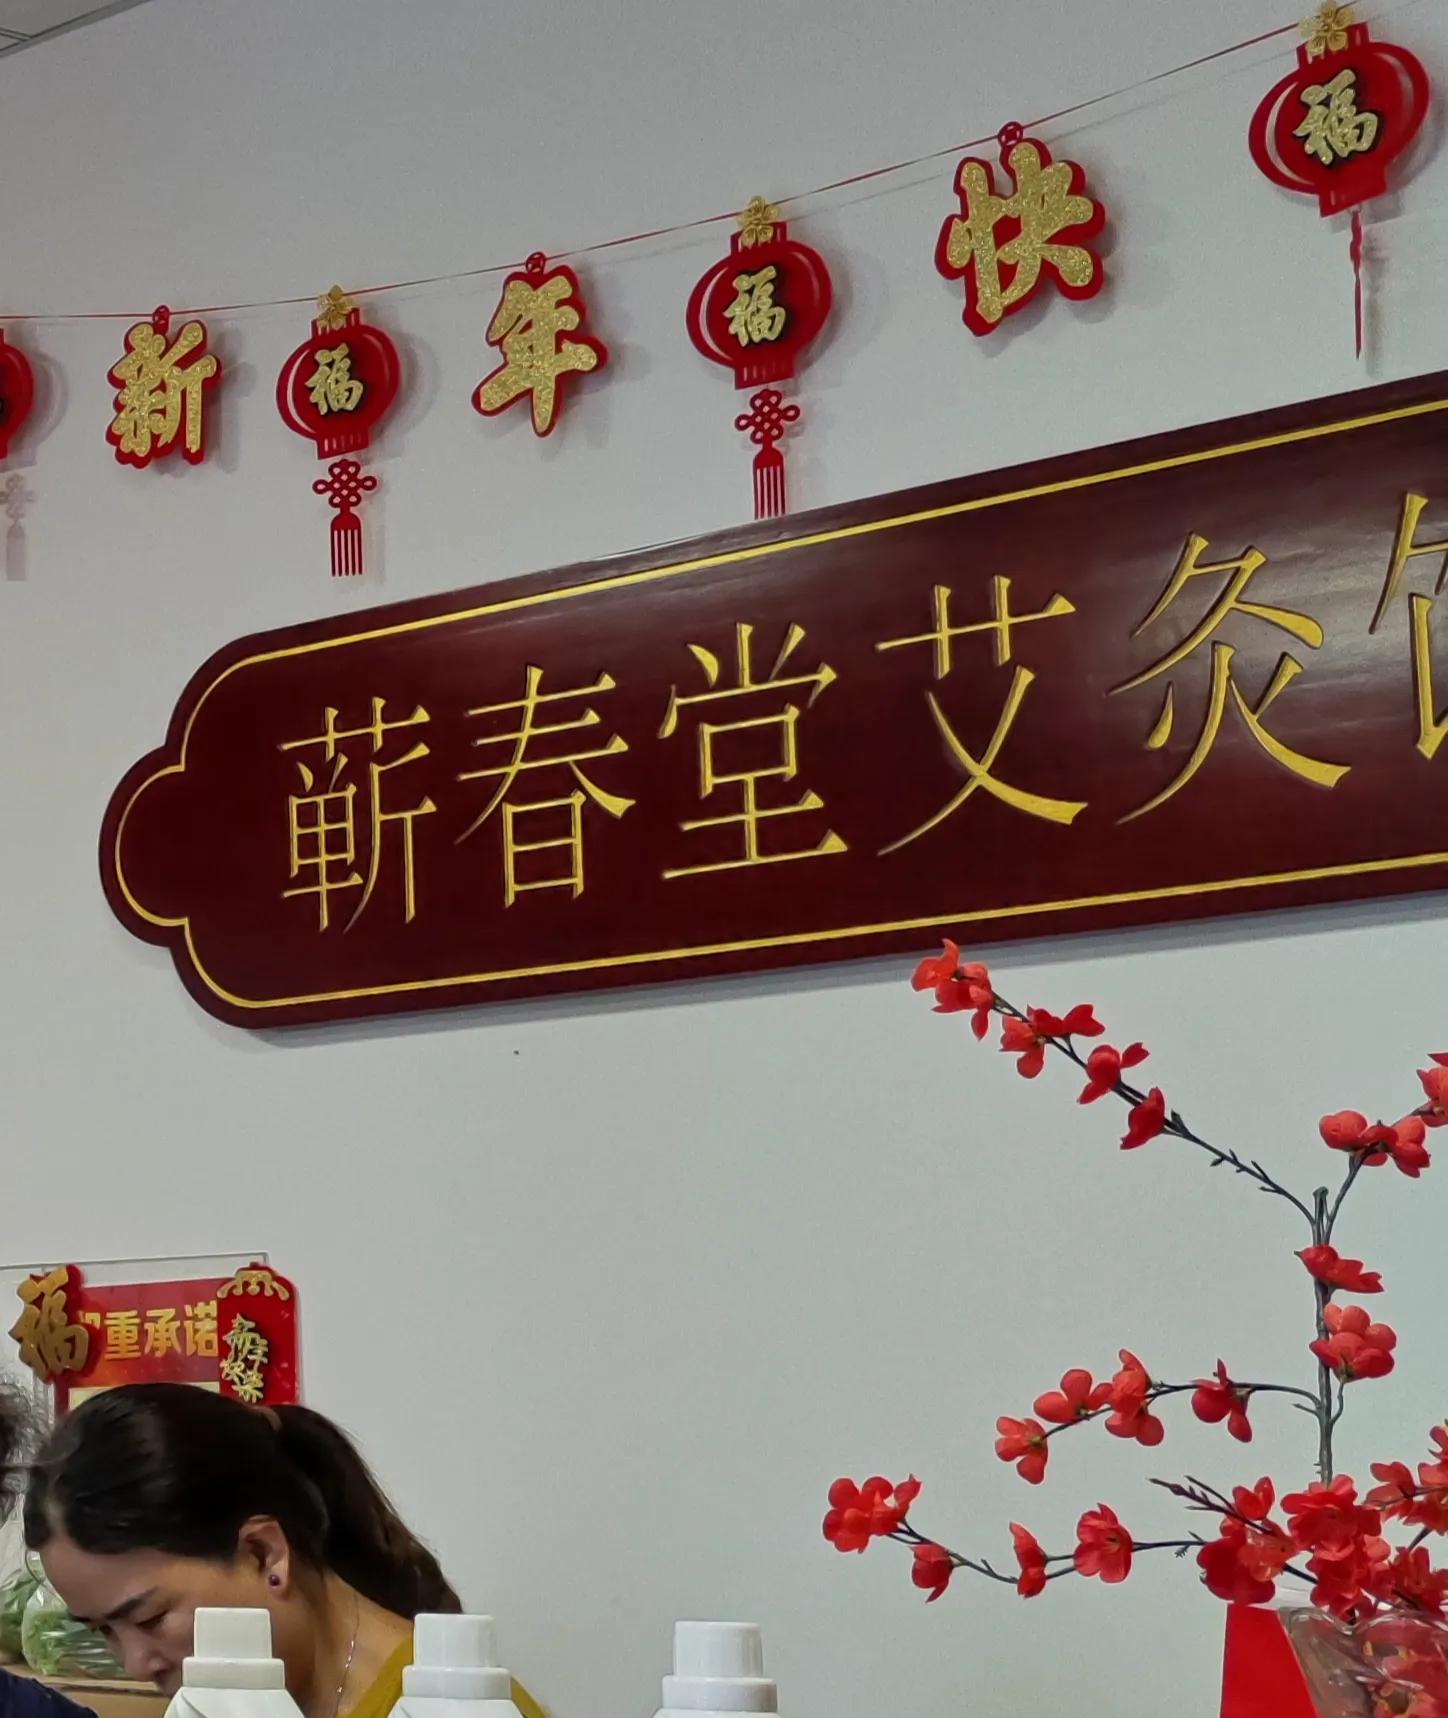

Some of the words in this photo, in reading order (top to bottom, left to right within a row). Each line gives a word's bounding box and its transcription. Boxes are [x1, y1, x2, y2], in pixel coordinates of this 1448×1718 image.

[1294, 69, 1380, 166] 福
[947, 141, 1095, 324] 快
[478, 274, 597, 433] 年
[724, 264, 786, 347] 福
[109, 321, 216, 457] 新
[304, 341, 365, 415] 福
